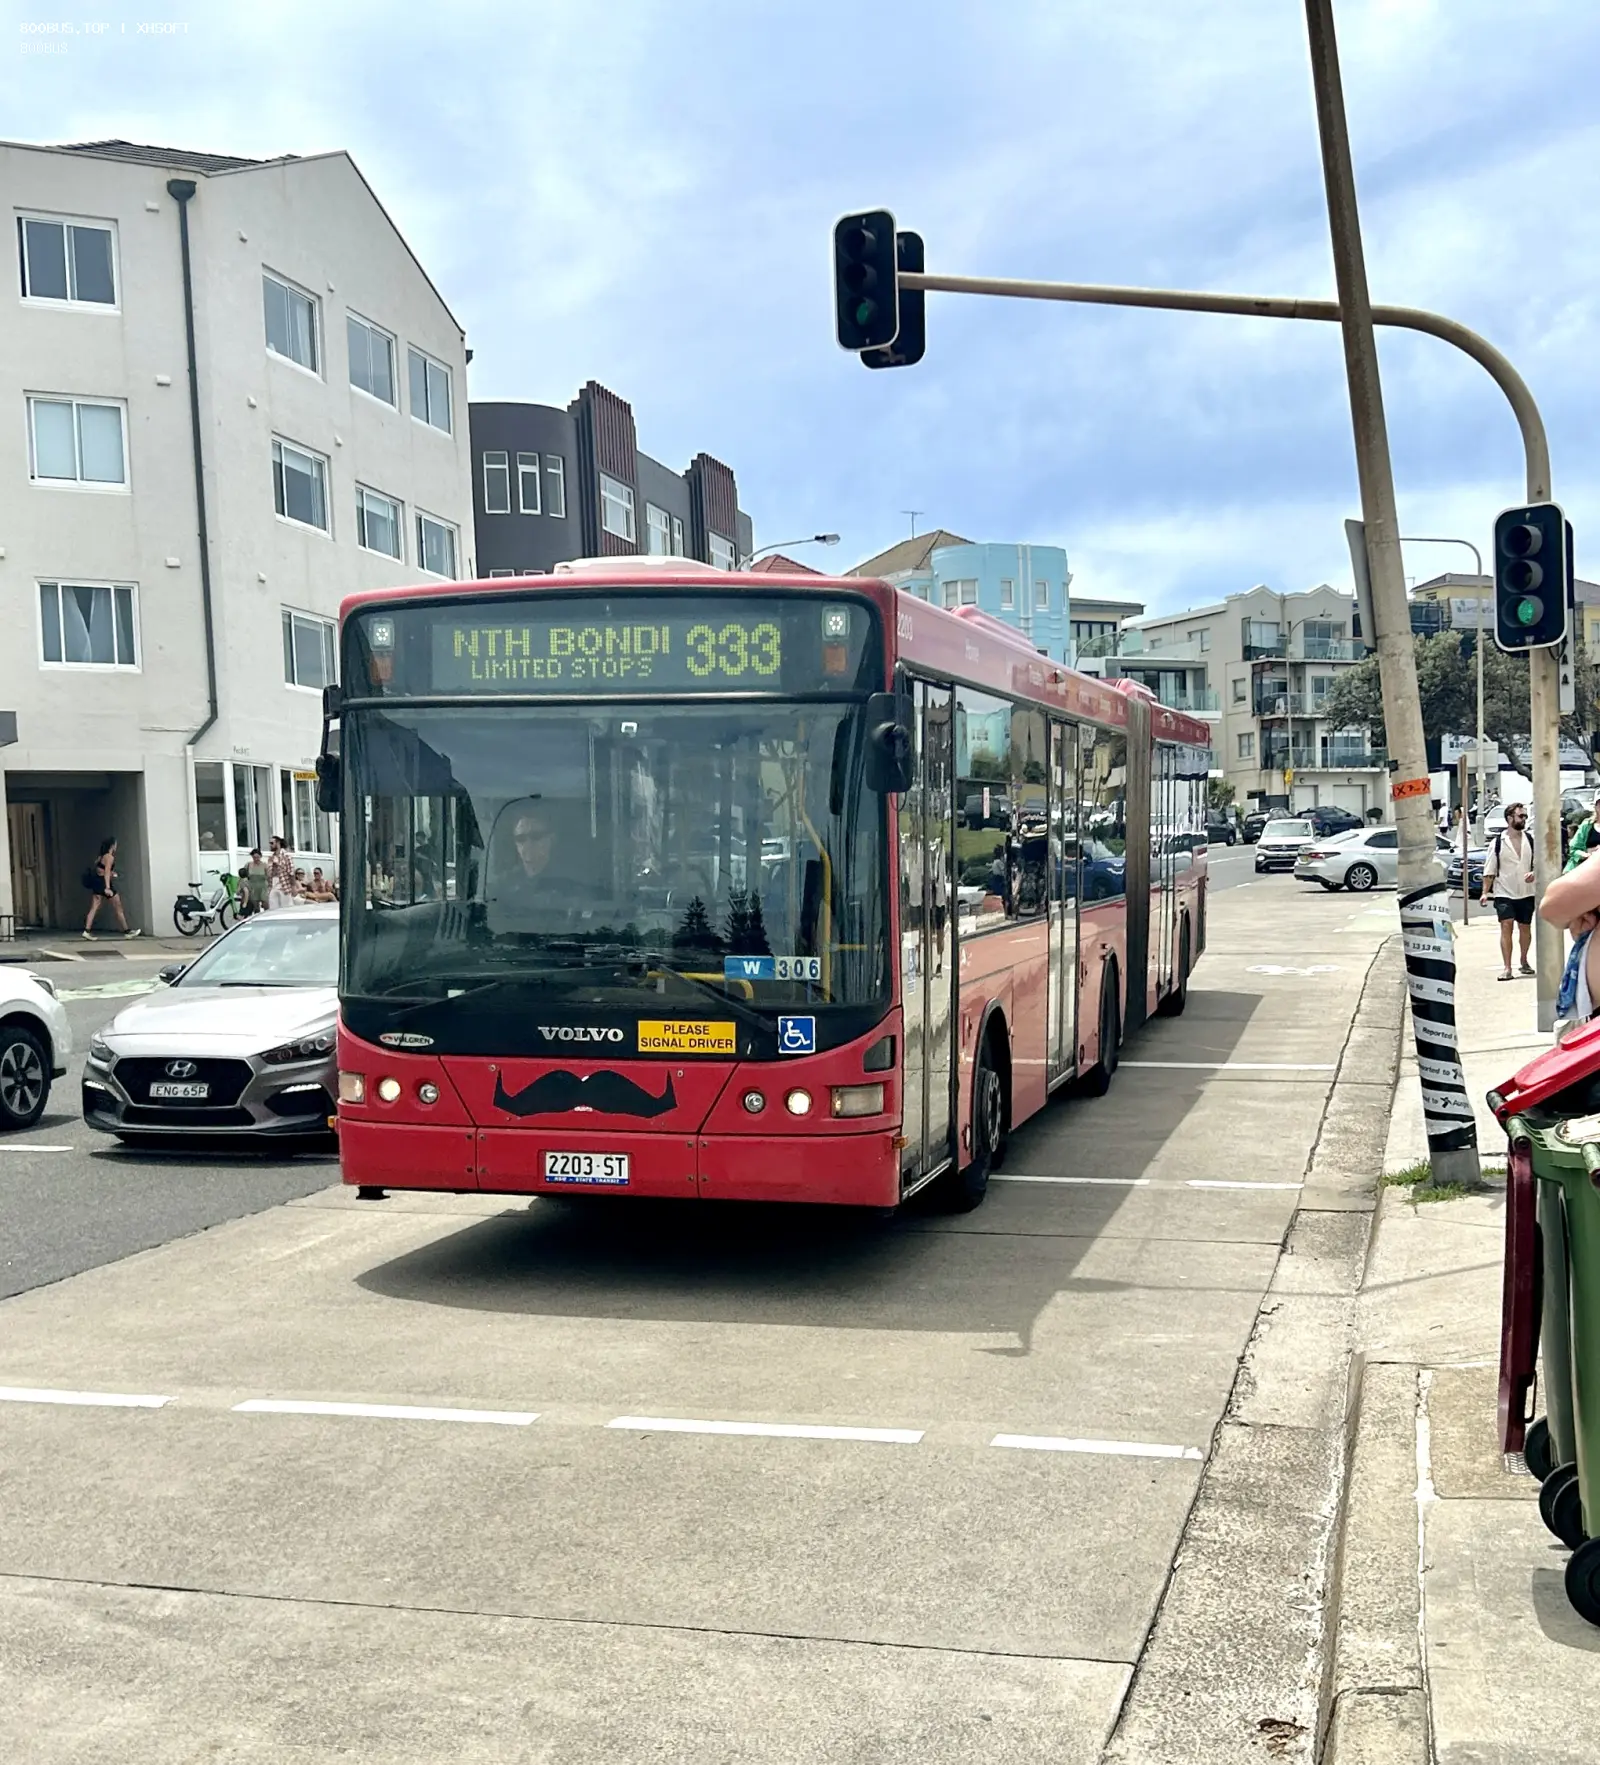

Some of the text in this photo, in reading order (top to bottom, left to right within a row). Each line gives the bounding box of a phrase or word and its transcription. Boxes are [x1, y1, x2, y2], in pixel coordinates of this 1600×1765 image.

[454, 623, 781, 676] NTH BONDI 333
[471, 656, 653, 679] LIMITED STOPS
[743, 960, 819, 978] W 306
[538, 1026, 624, 1042] VOLVO
[663, 1024, 710, 1035] PLEASE
[1422, 1026, 1453, 1040] Reported
[640, 1037, 733, 1049] SIGNAL DRIVER
